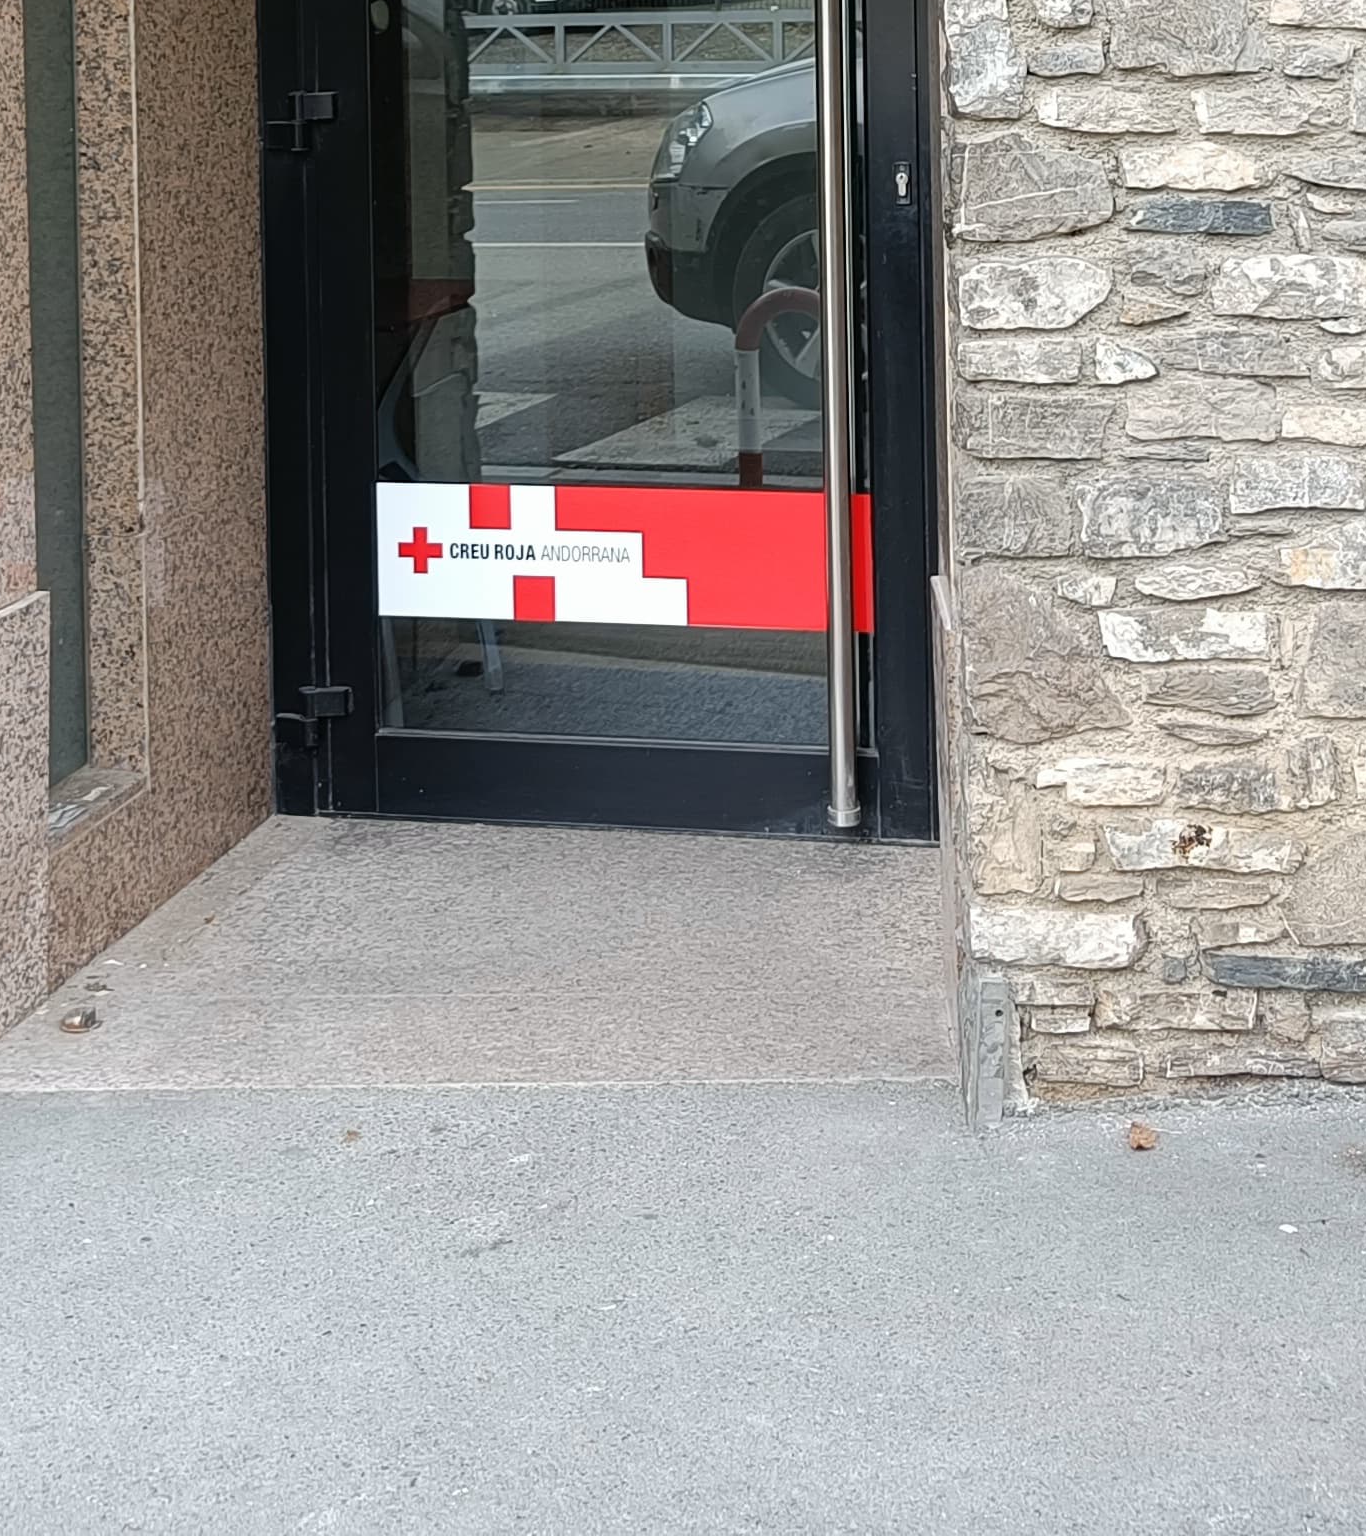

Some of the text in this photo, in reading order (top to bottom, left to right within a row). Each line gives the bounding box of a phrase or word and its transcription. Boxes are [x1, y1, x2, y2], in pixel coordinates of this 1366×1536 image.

[449, 542, 631, 563] CREU ROJA ANDORRANA
